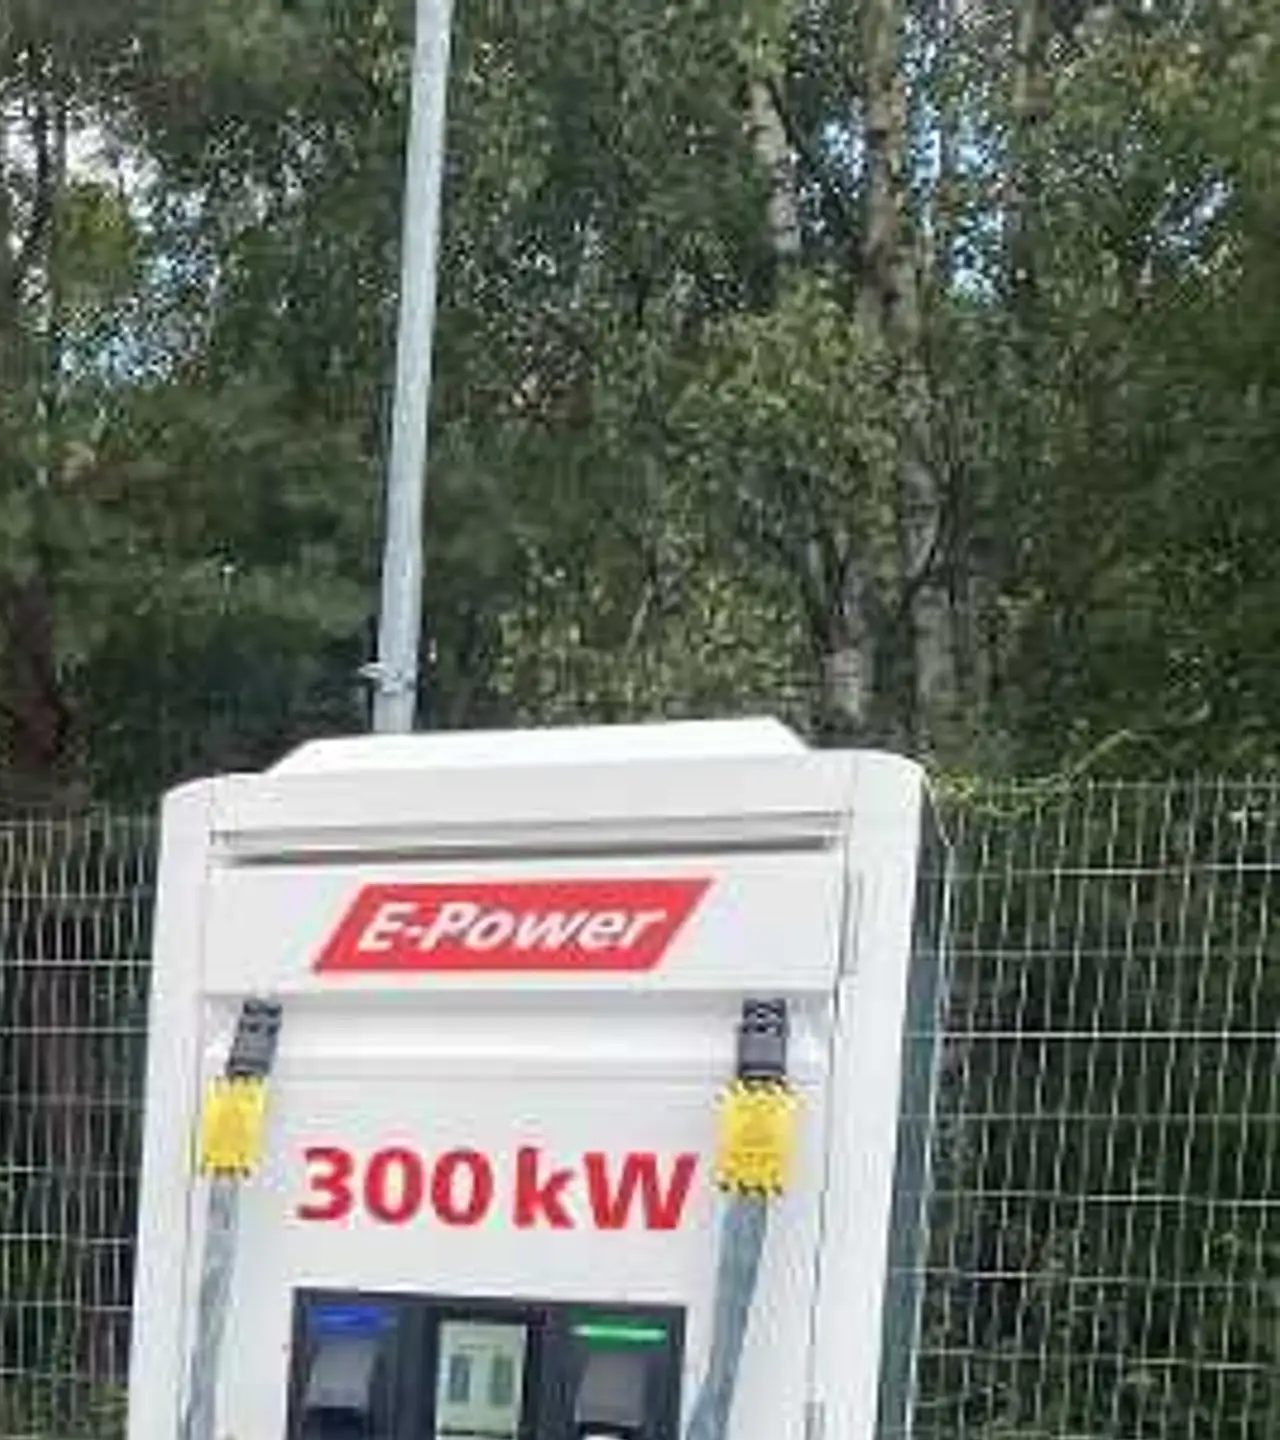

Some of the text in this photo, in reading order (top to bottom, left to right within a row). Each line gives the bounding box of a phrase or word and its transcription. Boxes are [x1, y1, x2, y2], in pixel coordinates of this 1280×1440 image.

[357, 899, 669, 954] E-Power
[296, 1146, 701, 1231] 300 kW
